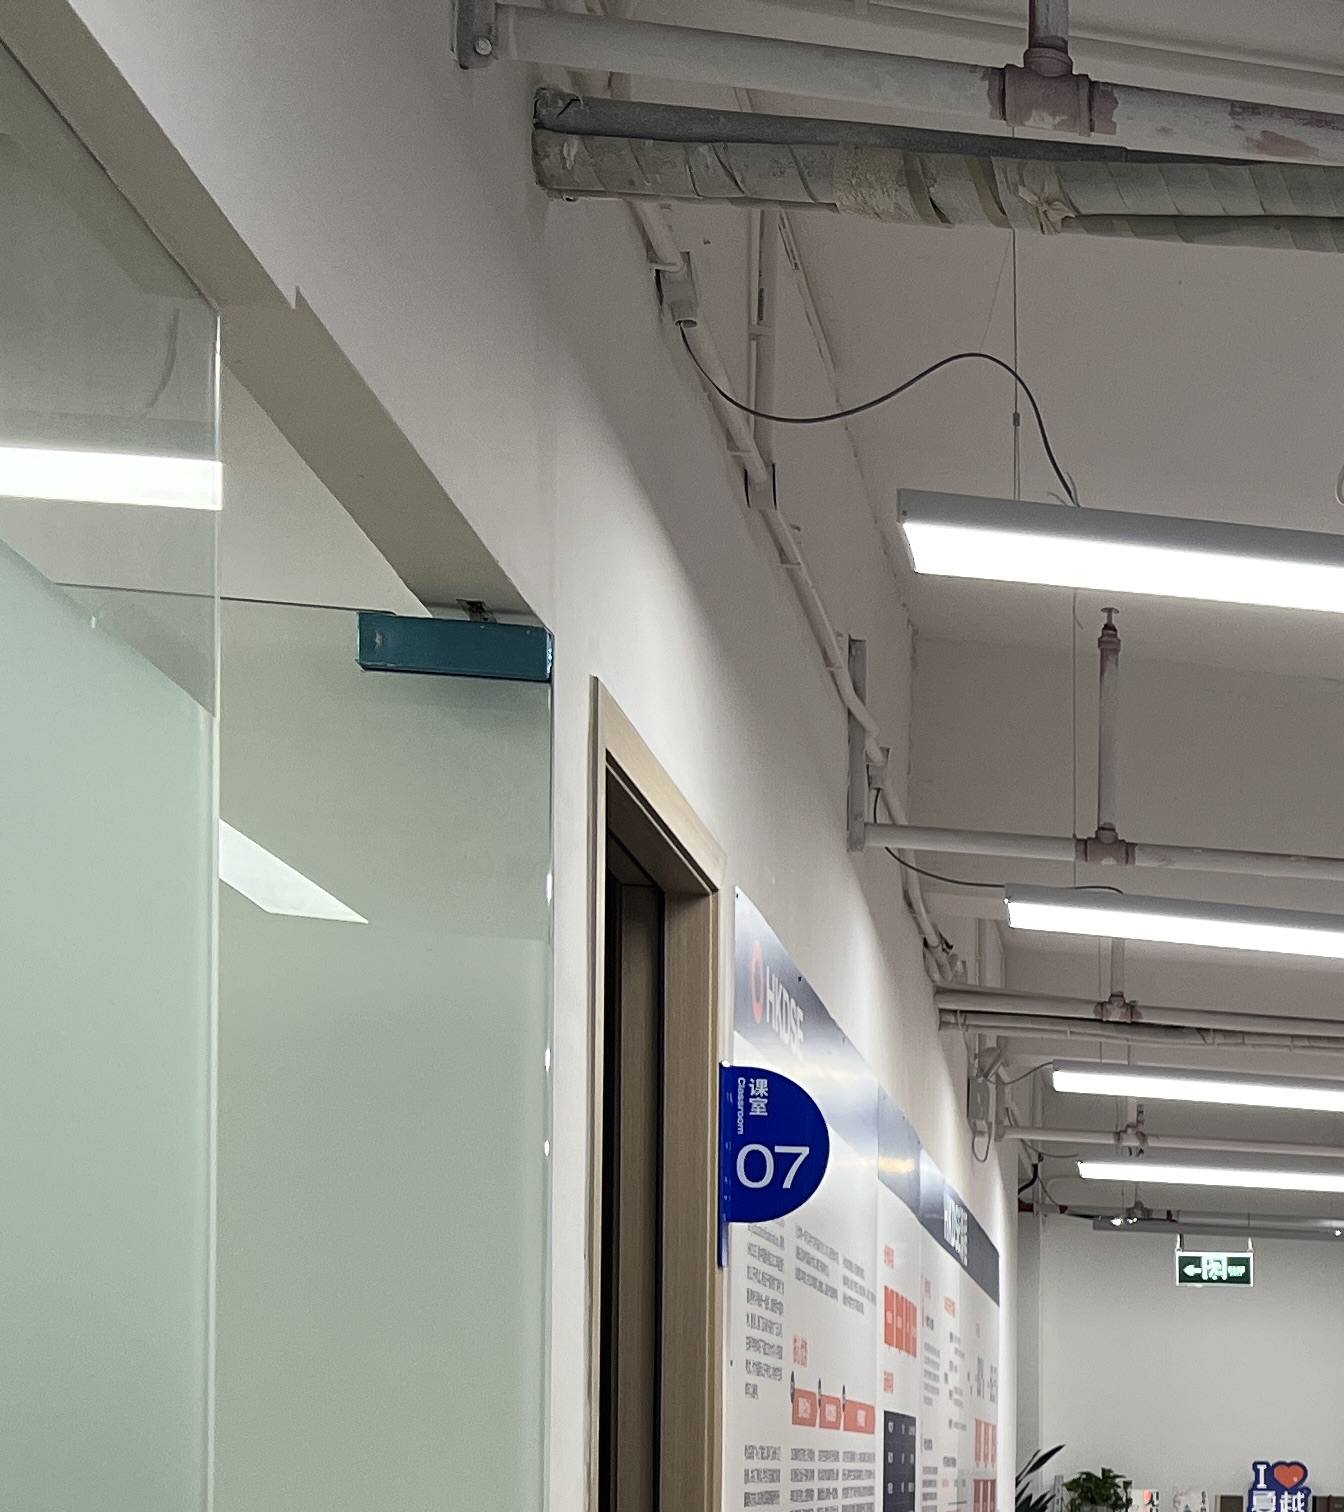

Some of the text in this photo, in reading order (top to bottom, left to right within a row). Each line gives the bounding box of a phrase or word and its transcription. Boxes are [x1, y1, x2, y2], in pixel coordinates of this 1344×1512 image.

[748, 1078, 768, 1116] 课室
[736, 1143, 810, 1190] 07
[1256, 1464, 1267, 1489] I
